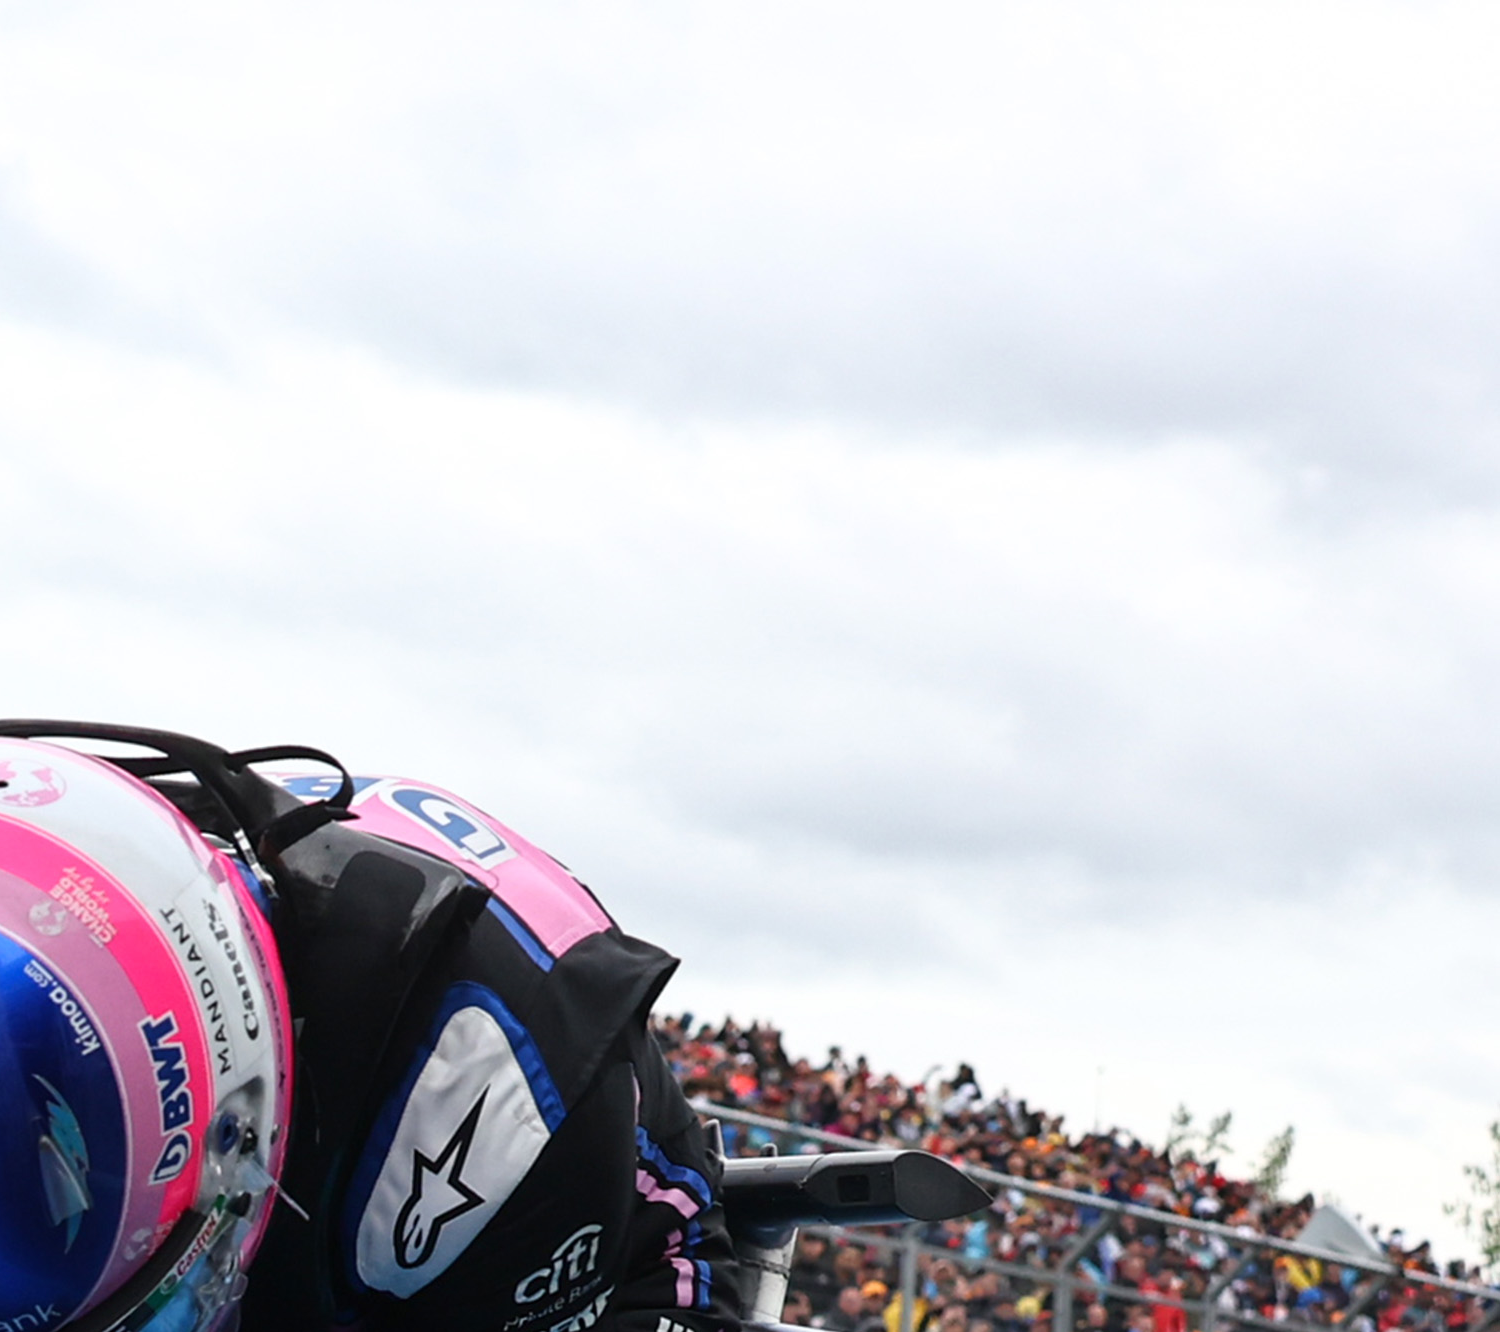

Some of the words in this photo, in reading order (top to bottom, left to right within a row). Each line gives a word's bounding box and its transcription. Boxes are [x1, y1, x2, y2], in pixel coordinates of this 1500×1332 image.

[48, 885, 117, 946] CHANGE
[159, 907, 233, 1075] MANDIANT
[139, 1010, 193, 1136] BWT
[513, 1226, 603, 1305] citi
